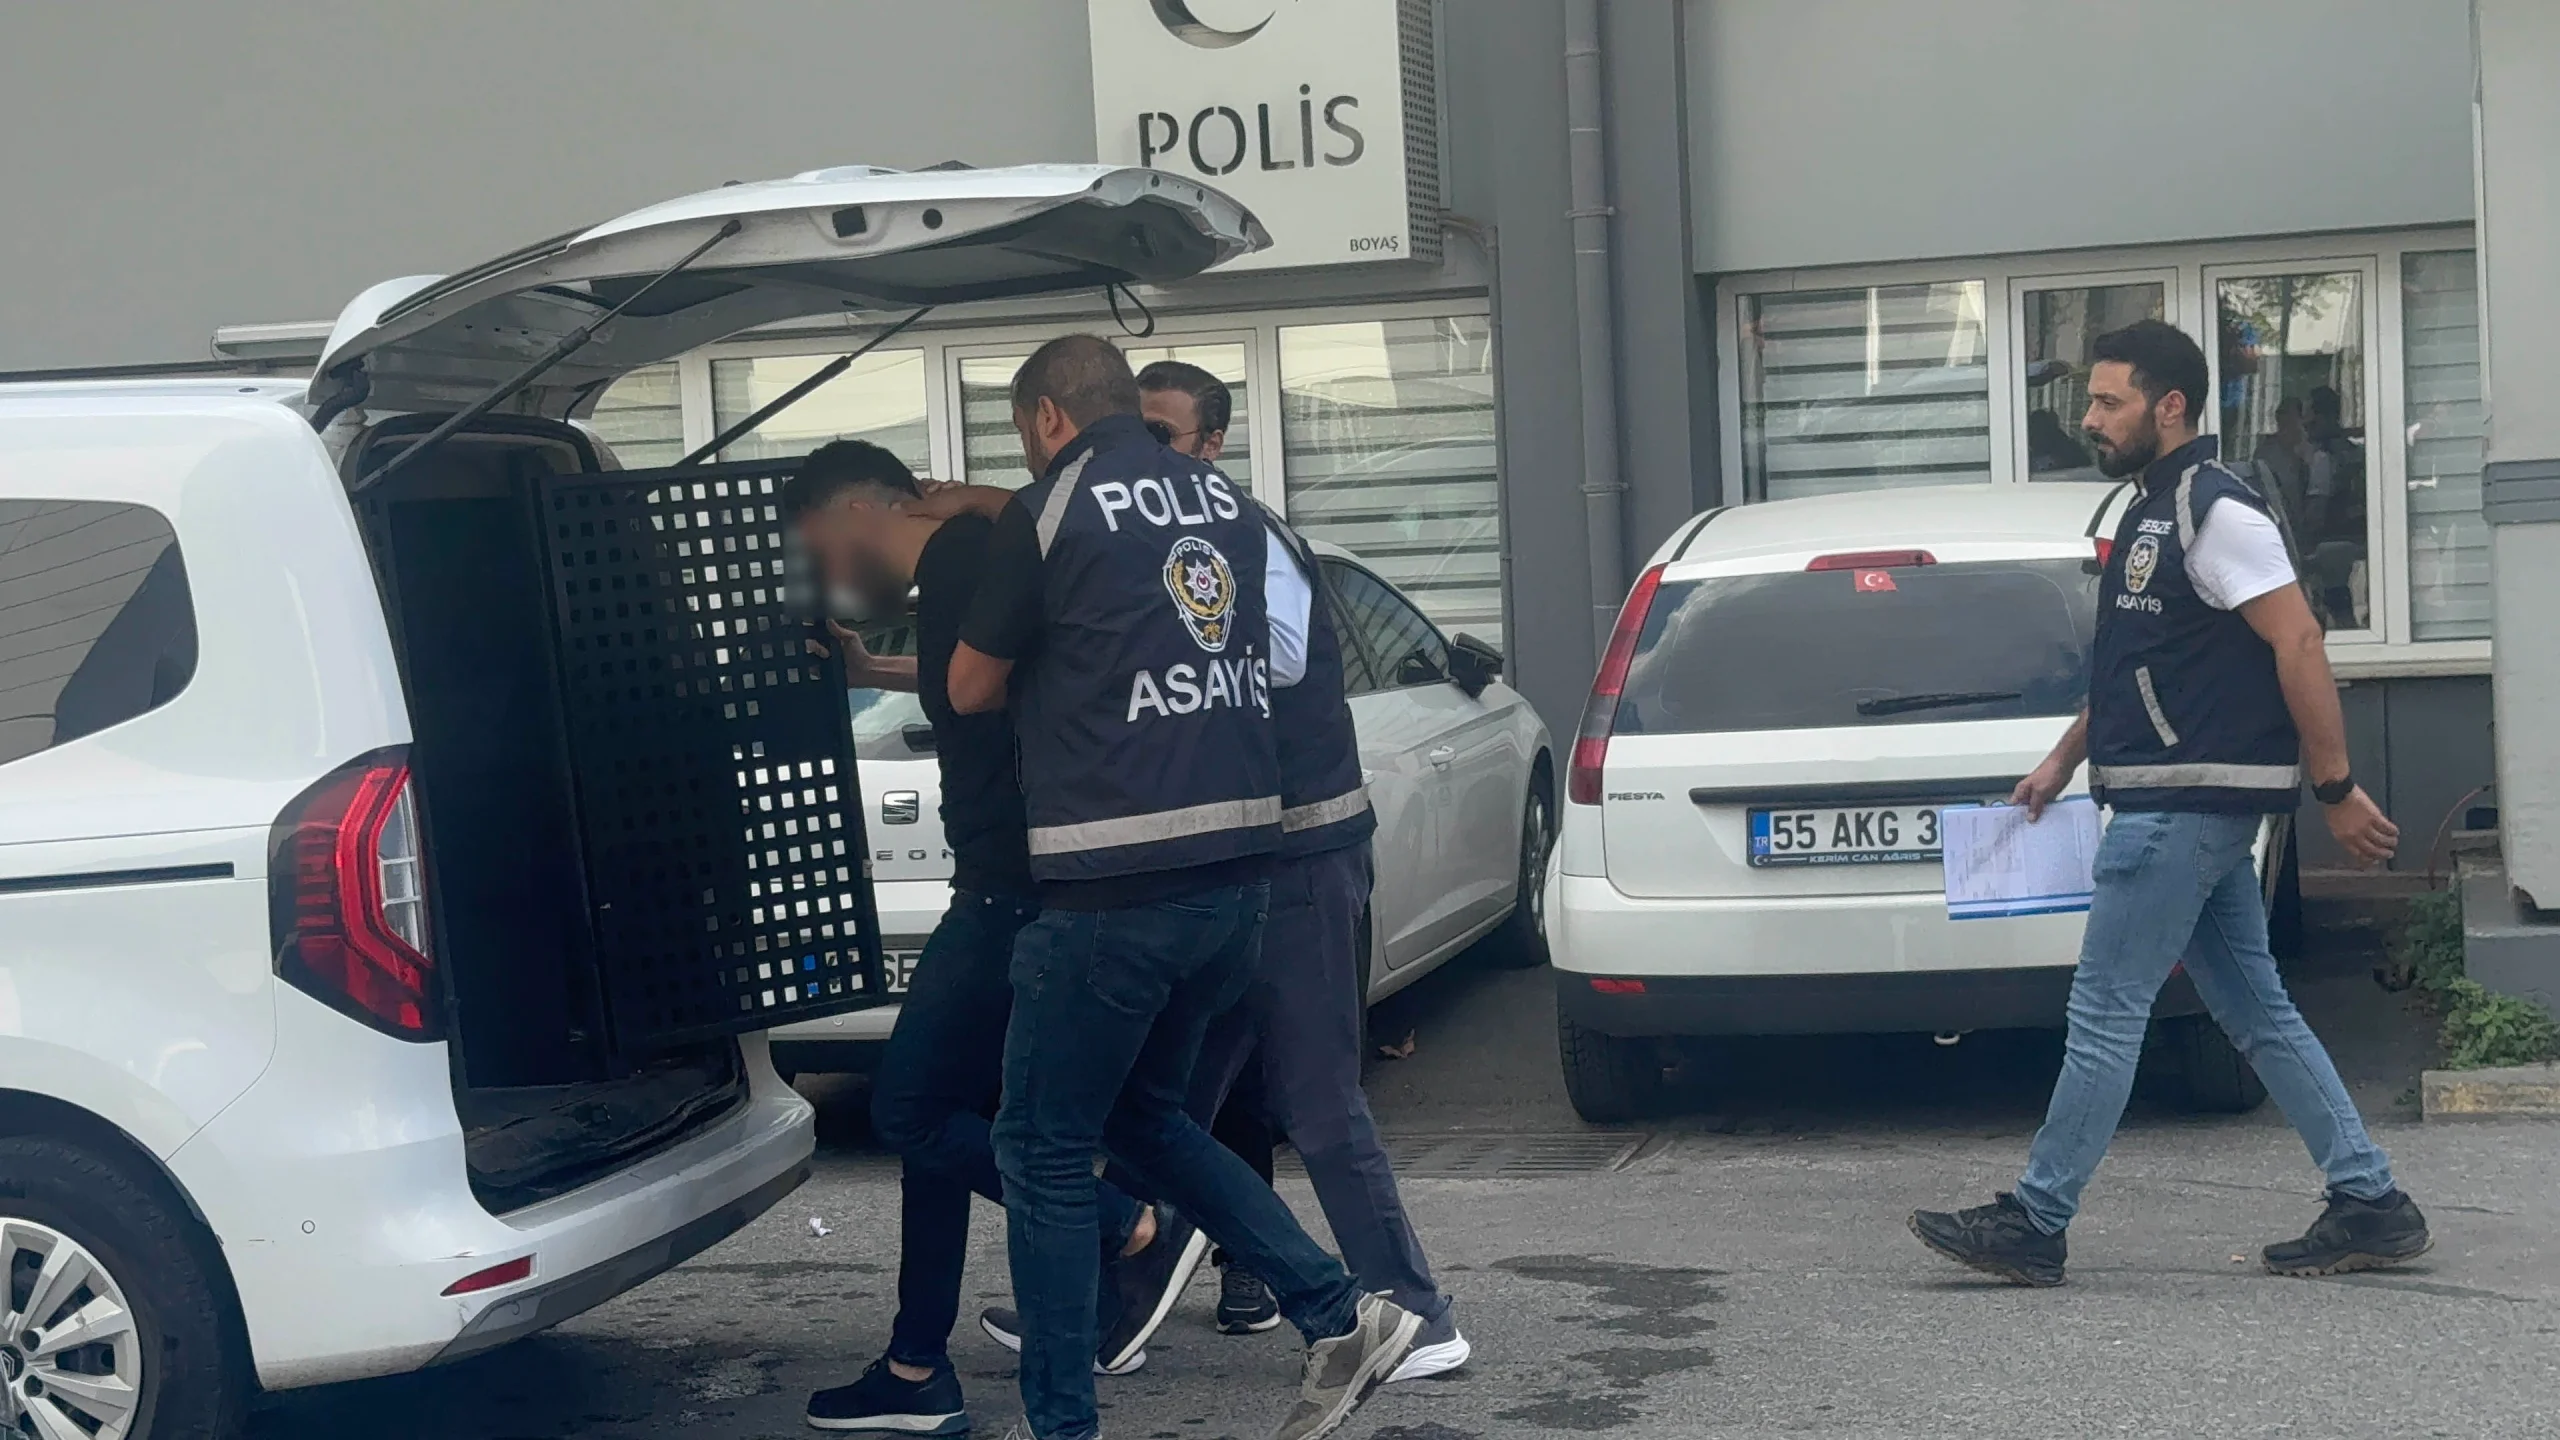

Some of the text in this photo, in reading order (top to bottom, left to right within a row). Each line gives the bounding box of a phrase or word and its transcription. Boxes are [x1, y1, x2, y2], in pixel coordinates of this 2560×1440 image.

[1138, 83, 1365, 176] POLİS
[1349, 236, 1399, 253] BOYAŞ
[1090, 474, 1240, 532] POLİS
[2115, 594, 2163, 615] ASAYİŞ
[1127, 645, 1271, 723] ASAYİŞ
[1607, 791, 1666, 801] FIESTA
[1773, 809, 1938, 850] 55 AKG 3
[1754, 835, 1769, 848] TR
[1852, 853, 1879, 863] CAN
